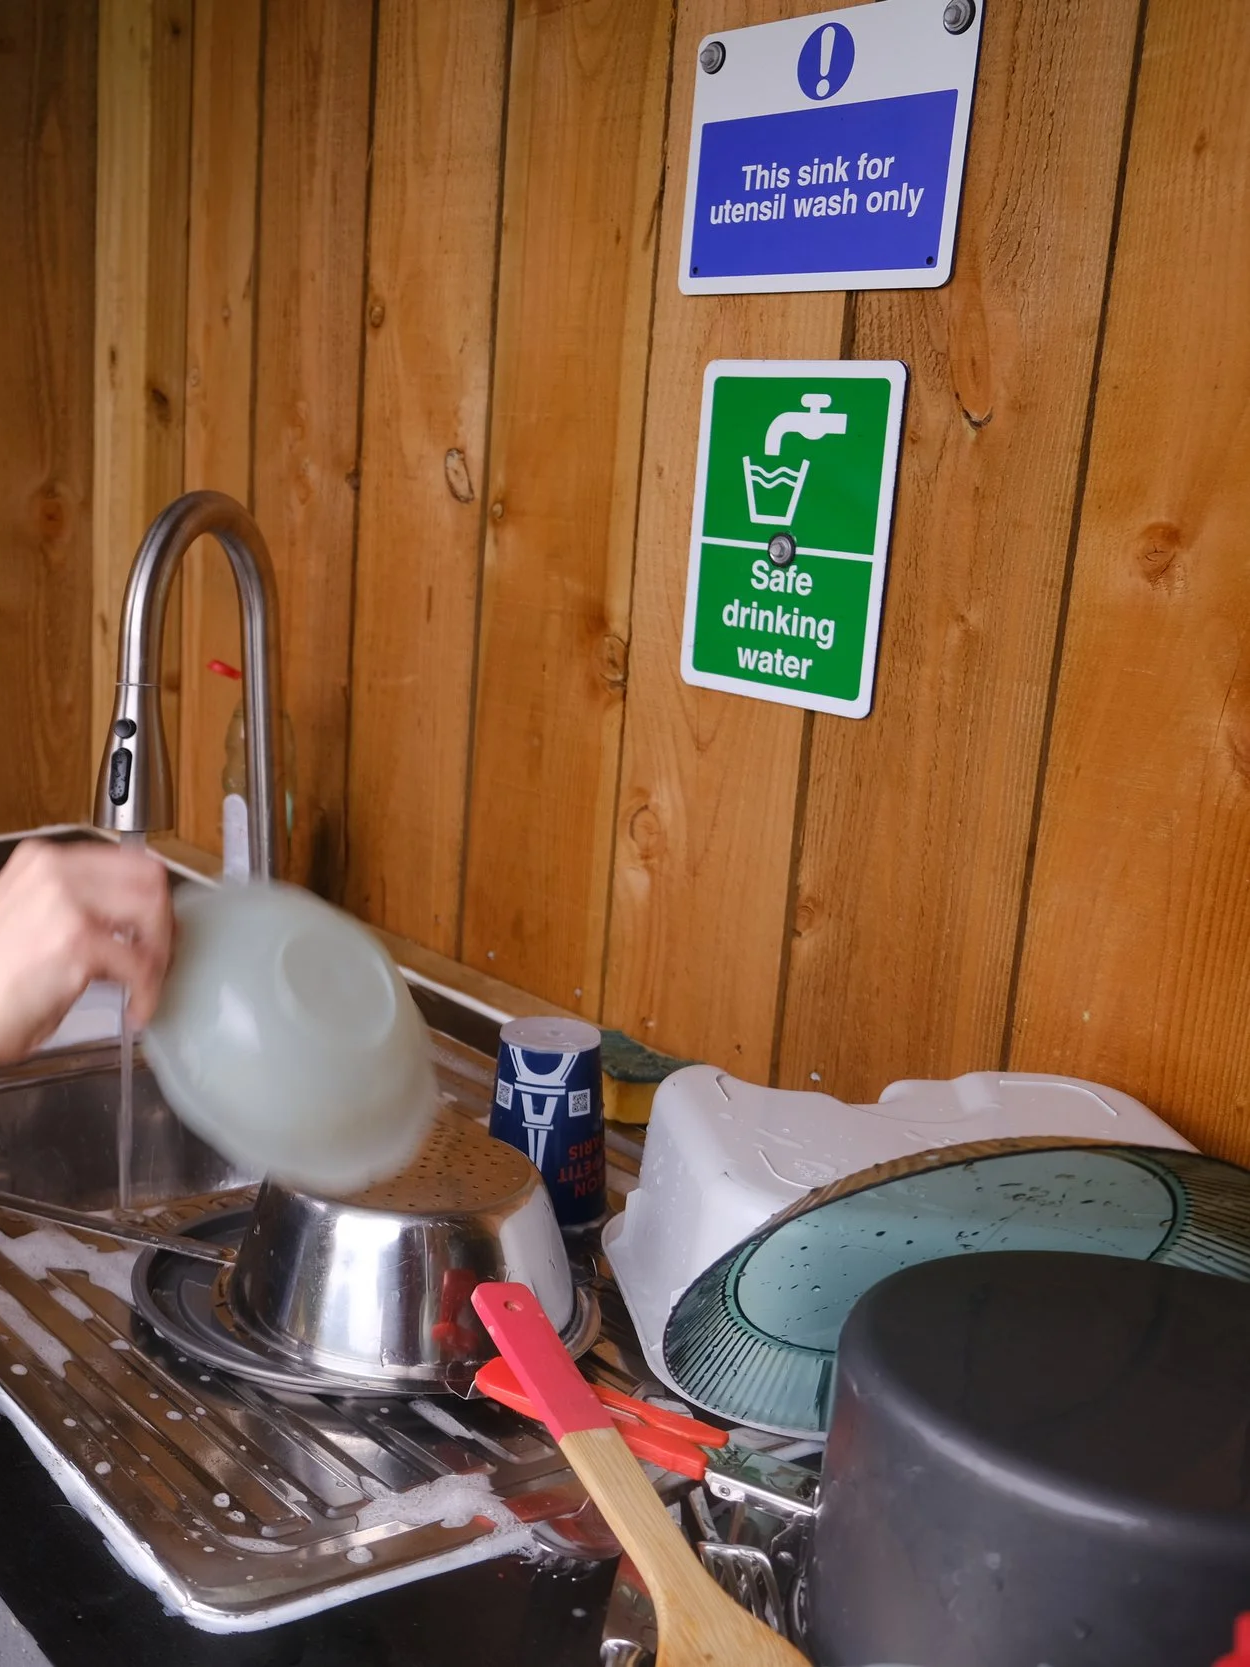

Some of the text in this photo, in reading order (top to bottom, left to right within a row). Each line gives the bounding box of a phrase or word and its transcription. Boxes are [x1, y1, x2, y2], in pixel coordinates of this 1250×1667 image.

[741, 153, 895, 191] This sink for
[710, 182, 924, 225] utensil wash only
[750, 559, 813, 596] Safe
[722, 598, 836, 650] drinking
[737, 646, 813, 680] water
[568, 1136, 603, 1161] ARIS
[574, 1175, 602, 1199] ON
